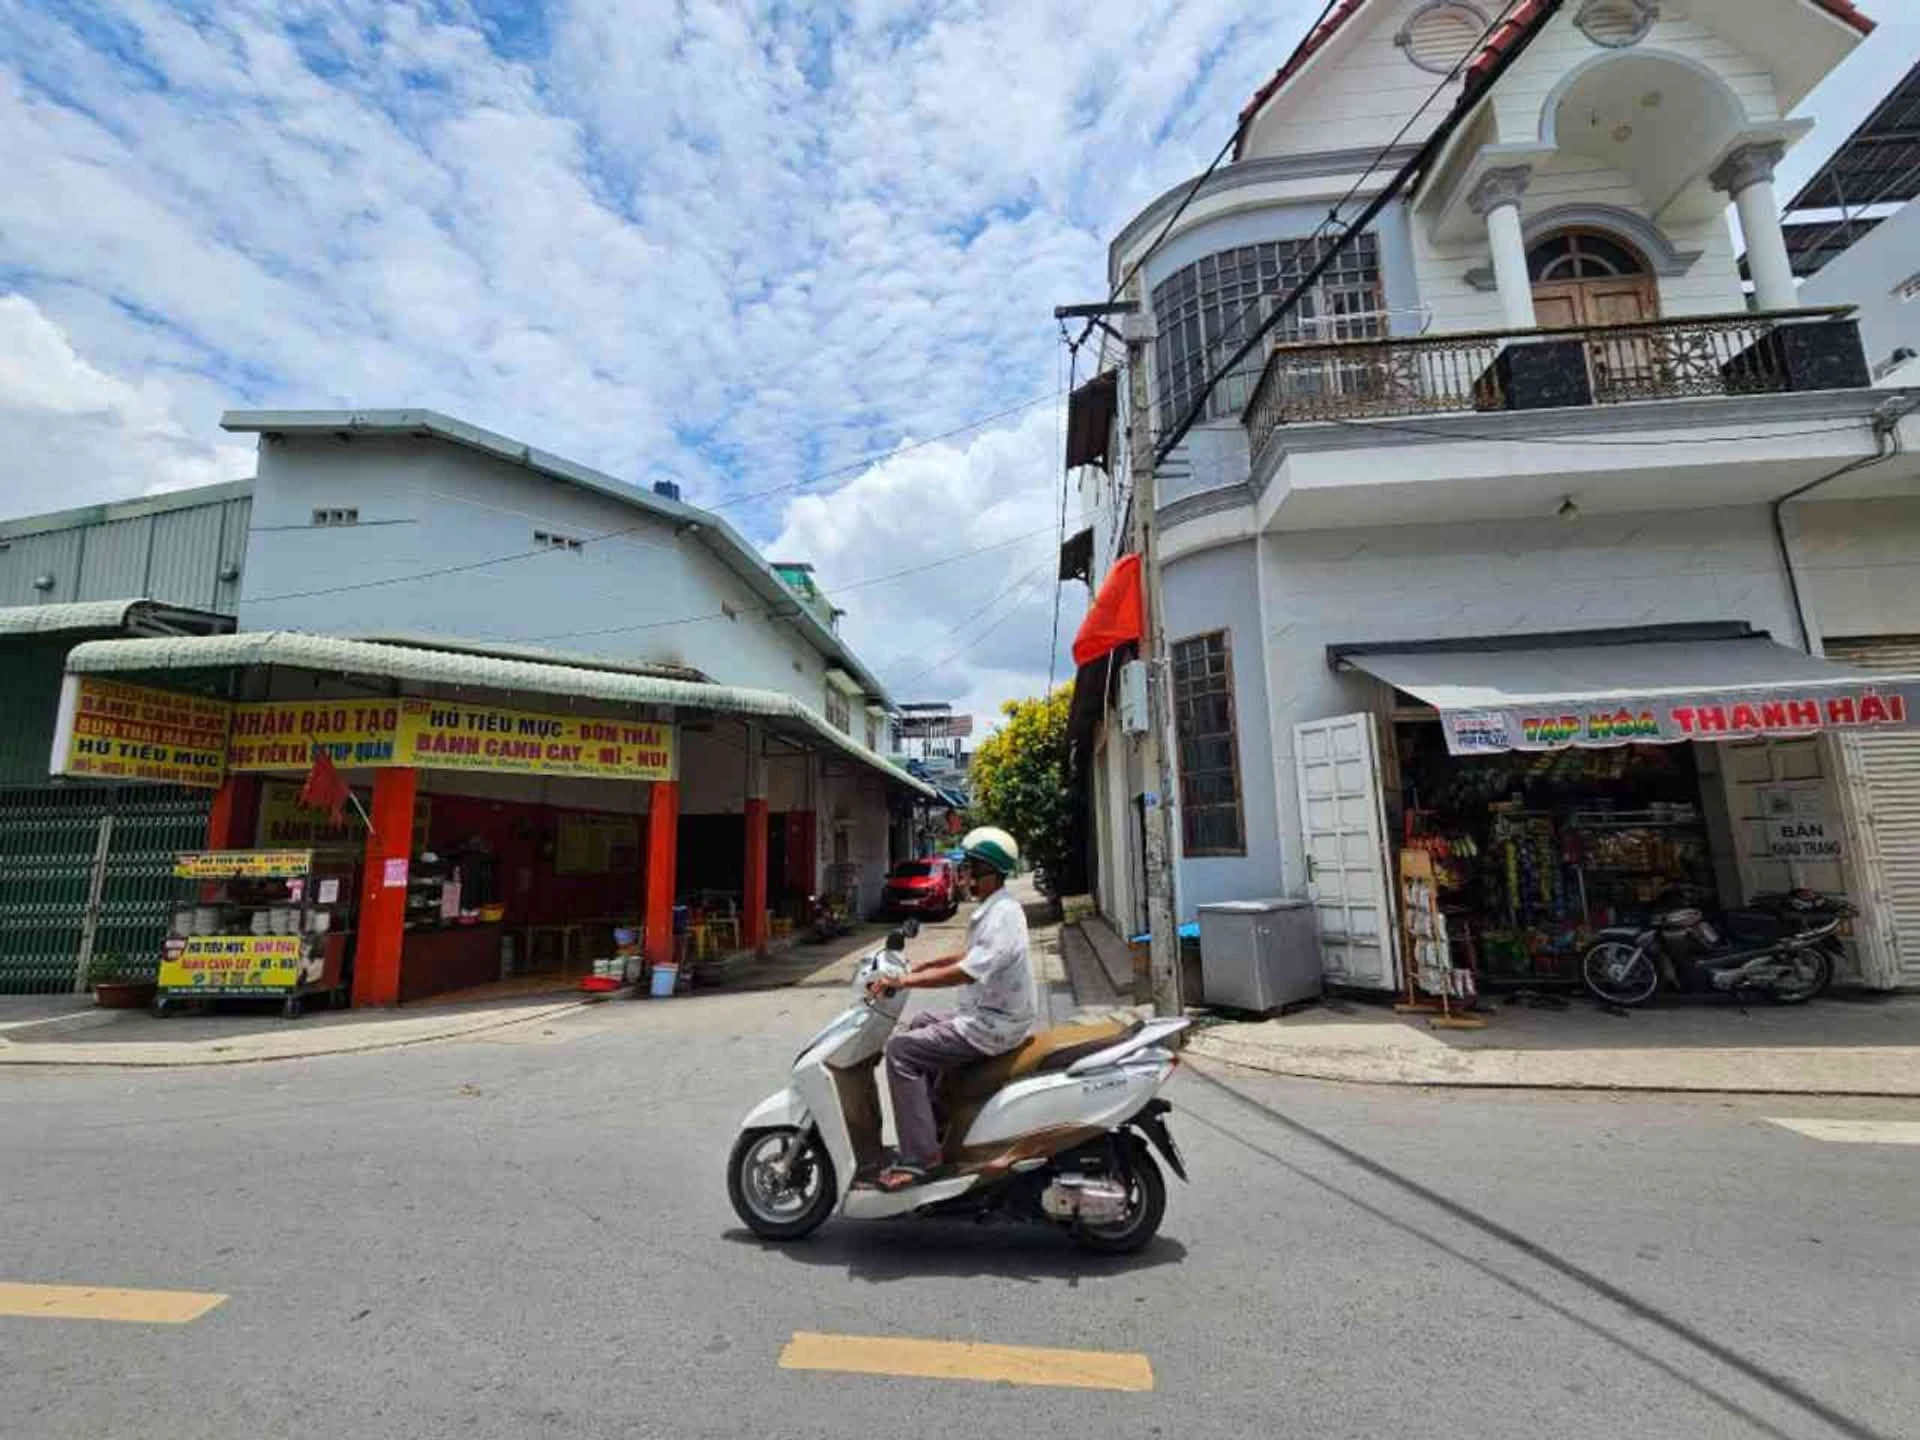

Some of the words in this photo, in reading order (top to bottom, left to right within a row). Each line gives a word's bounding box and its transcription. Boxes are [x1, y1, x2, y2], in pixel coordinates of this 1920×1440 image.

[230, 706, 296, 740] NHẬN
[353, 708, 399, 737] TẠO
[1671, 699, 1822, 733] THANH
[1827, 686, 1907, 723] HẢI
[416, 731, 480, 754] BÁNH
[485, 737, 542, 760] CANH
[547, 743, 583, 761] CAY
